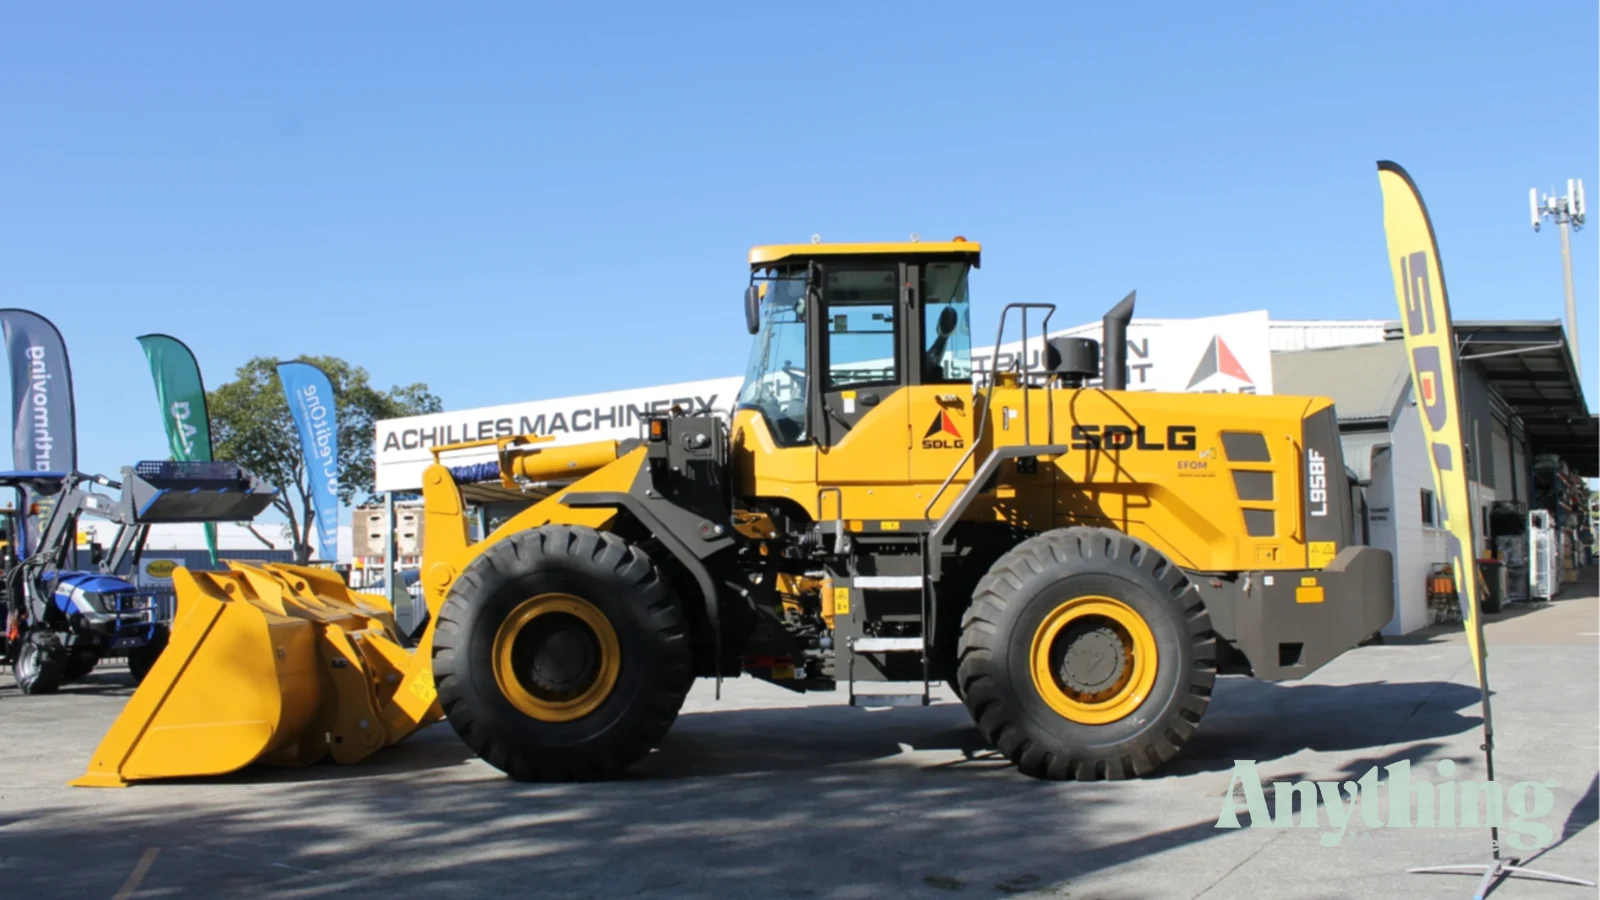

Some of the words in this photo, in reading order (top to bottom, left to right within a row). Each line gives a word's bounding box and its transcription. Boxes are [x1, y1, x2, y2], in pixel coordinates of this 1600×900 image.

[383, 418, 514, 452] ACHILLES
[520, 394, 719, 437] MACHINERY
[1071, 425, 1196, 450] SDLG
[922, 440, 964, 449] SDLG
[1308, 448, 1327, 516] L958F
